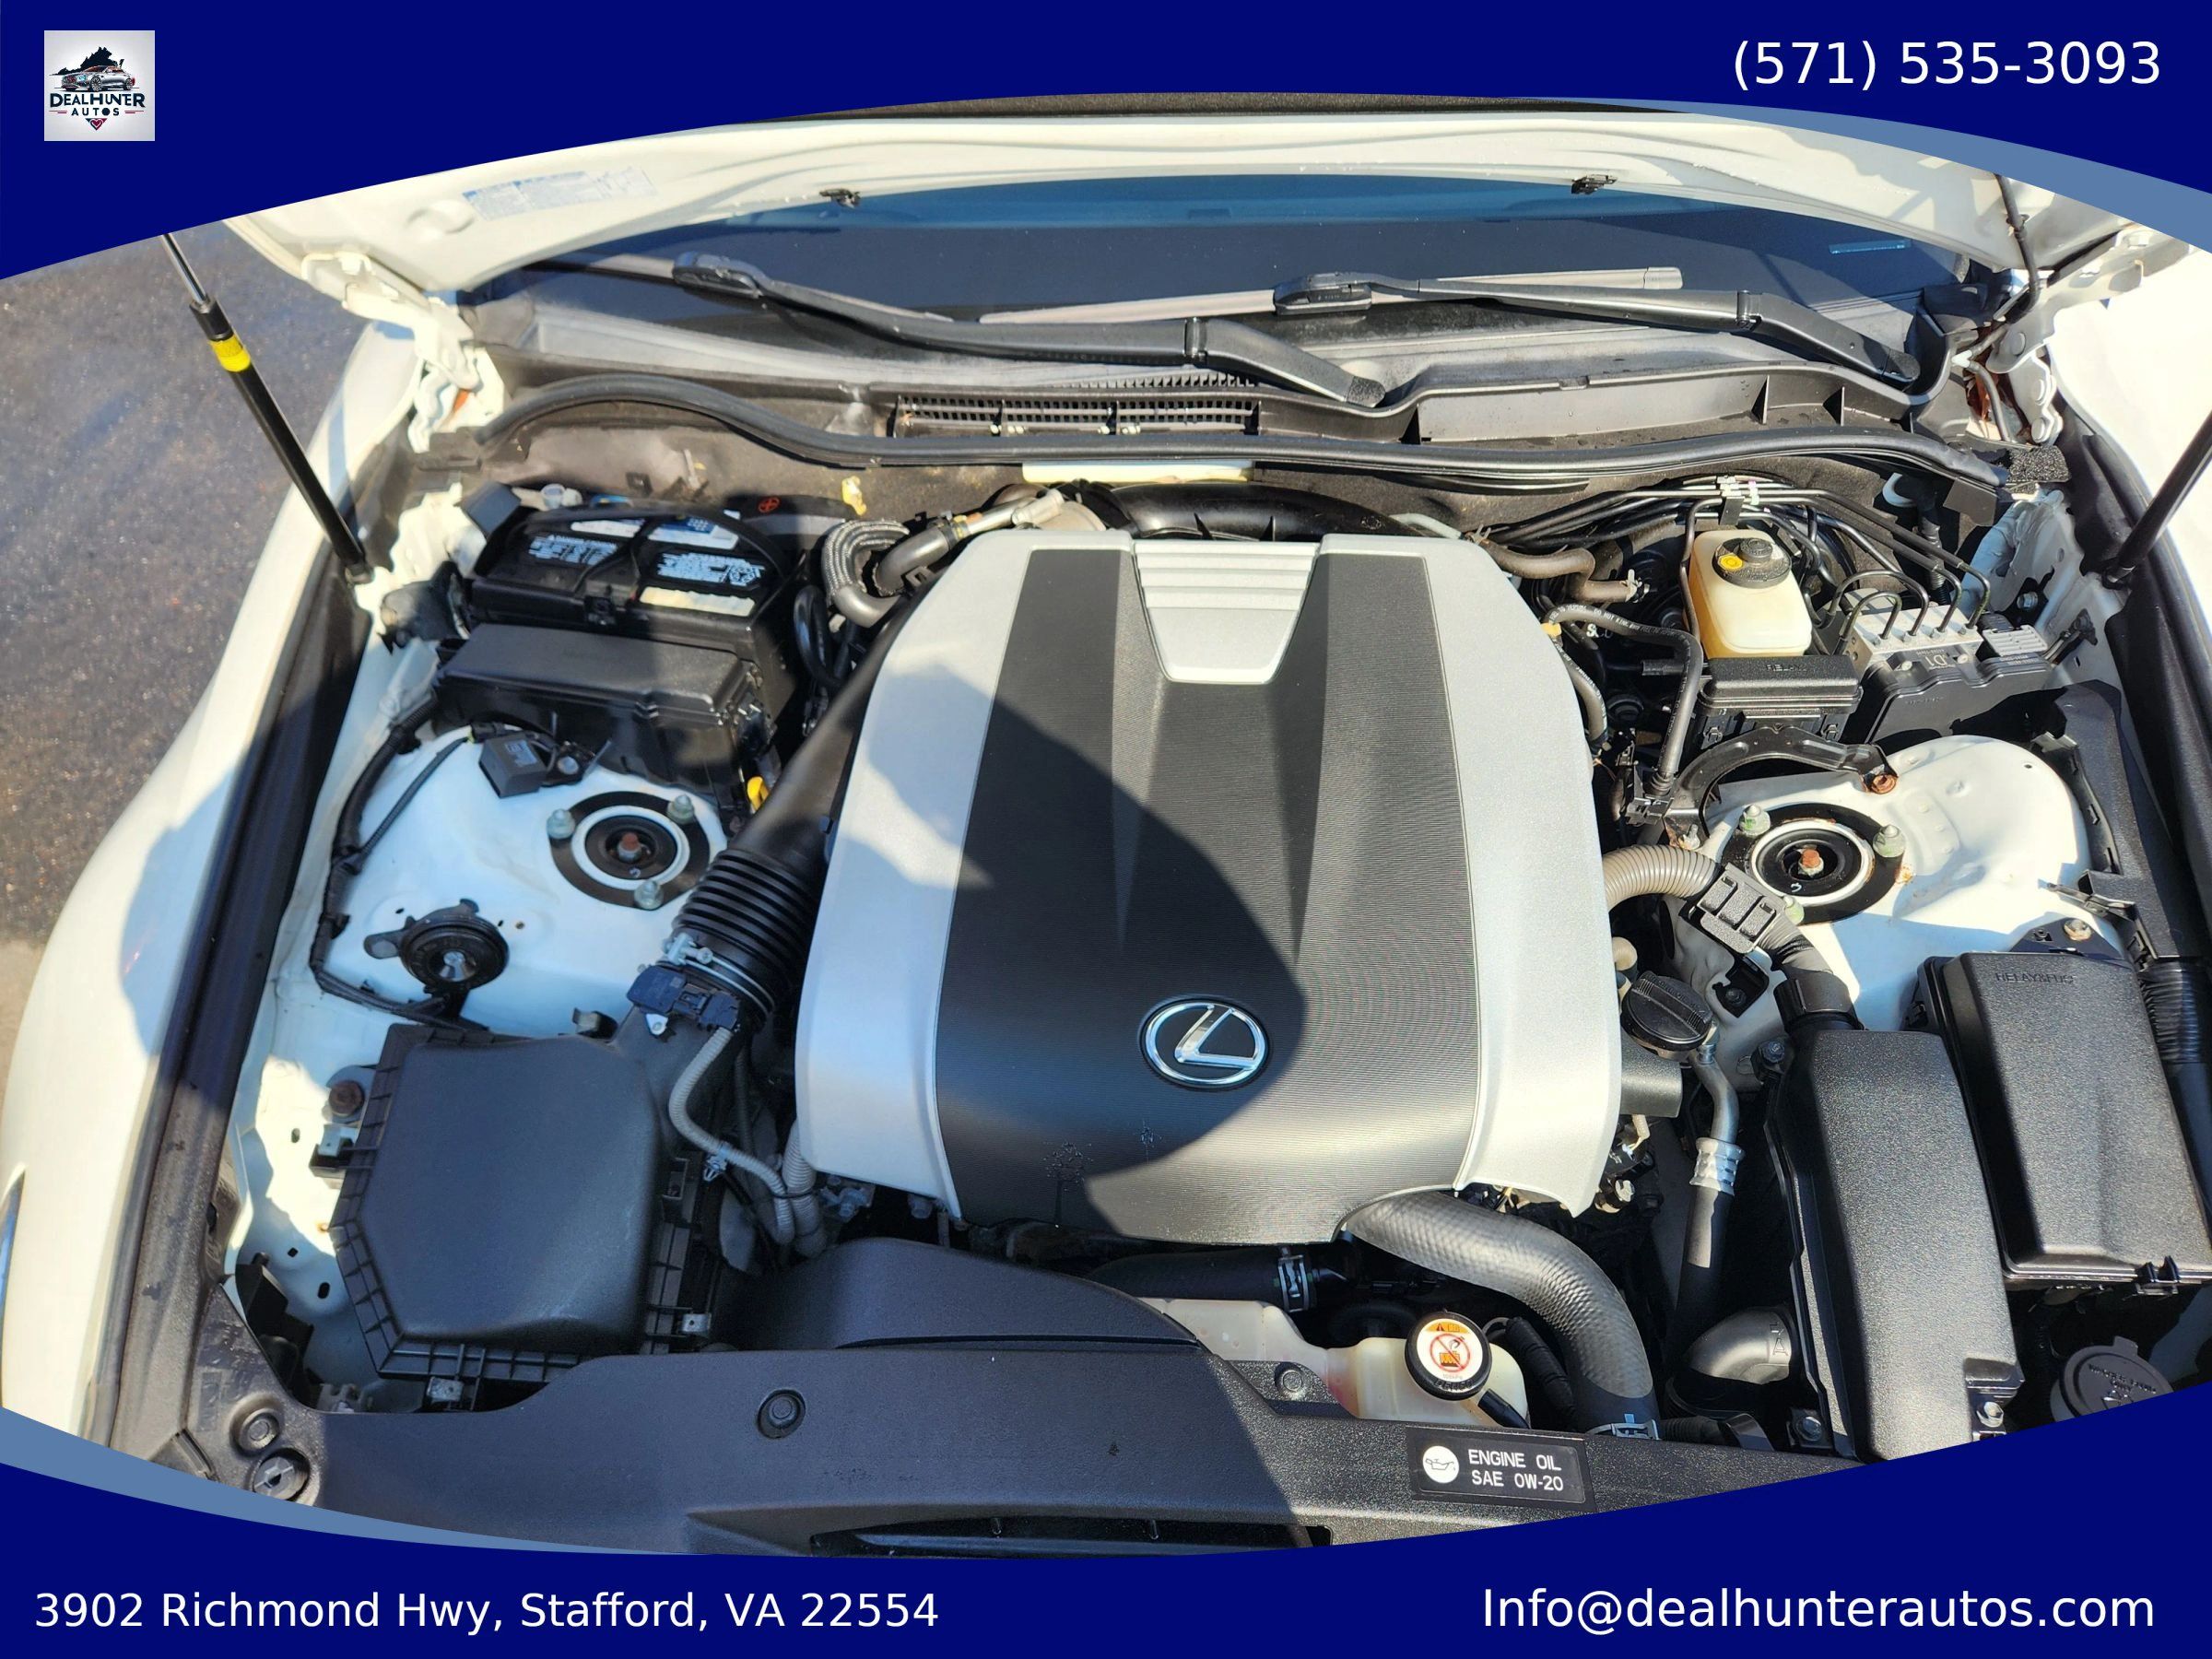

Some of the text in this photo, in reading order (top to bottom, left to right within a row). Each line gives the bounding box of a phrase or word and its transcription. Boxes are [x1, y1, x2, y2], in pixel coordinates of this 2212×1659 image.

[1468, 1449, 1562, 1471] ENGINE OIL
[1472, 1469, 1564, 1491] SAE 0W-20
